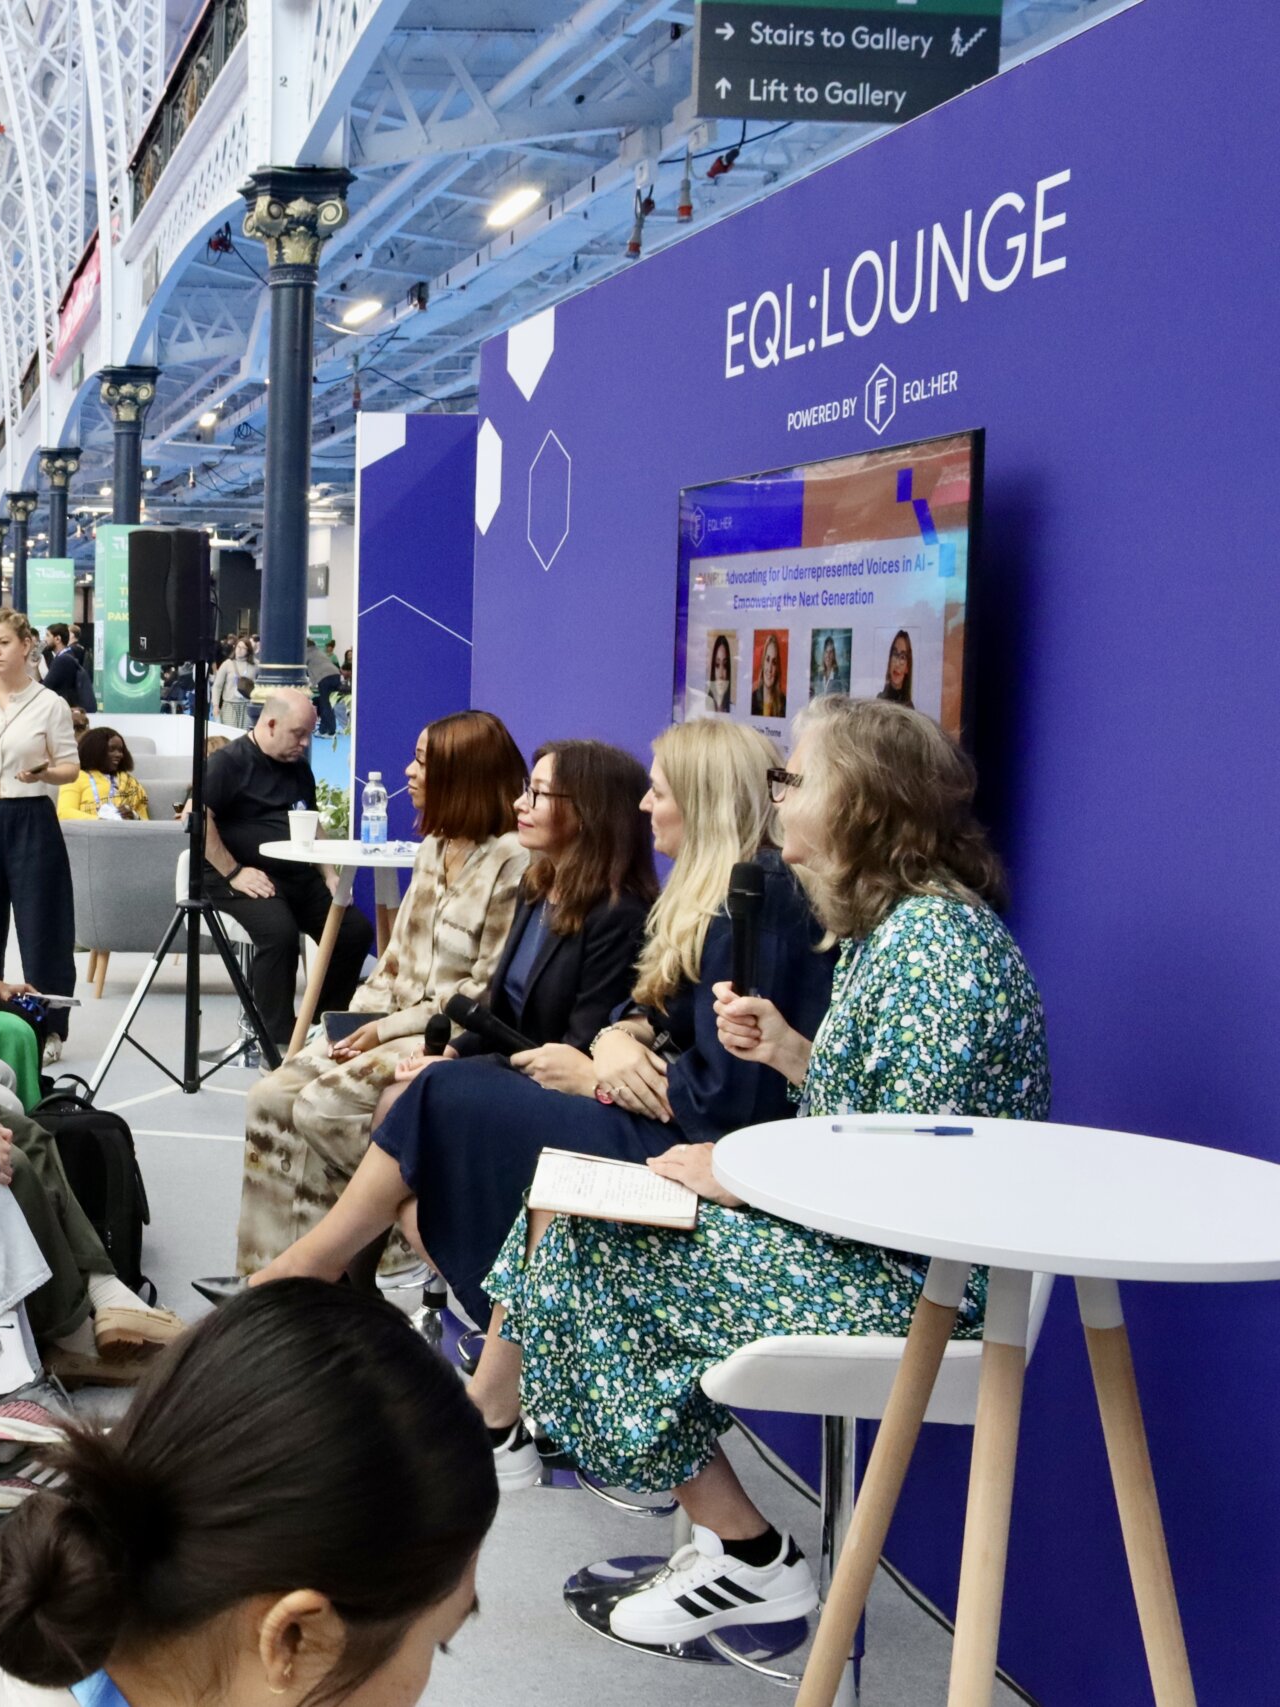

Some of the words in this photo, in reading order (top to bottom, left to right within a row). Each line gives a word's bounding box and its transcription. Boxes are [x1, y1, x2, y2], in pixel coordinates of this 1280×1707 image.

[749, 21, 815, 47] Stairs
[821, 26, 845, 48] to
[851, 26, 934, 59] Gallery
[279, 76, 287, 87] 2
[749, 78, 789, 103] Lift
[793, 81, 819, 104] to
[824, 82, 908, 113] Gallery
[725, 168, 1071, 379] EQL:LOUNGE
[787, 400, 840, 432] POWERED
[842, 396, 858, 418] BY
[903, 370, 959, 404] EQL:HER
[725, 567, 768, 586] Advocating
[769, 565, 781, 582] for
[781, 558, 865, 586] Underrepresented
[866, 558, 900, 576] Voices
[902, 557, 912, 573] in
[914, 553, 926, 572] AI
[733, 593, 782, 612] Empowering
[783, 592, 797, 608] the
[798, 591, 820, 607] Next
[821, 588, 875, 607] Generation
